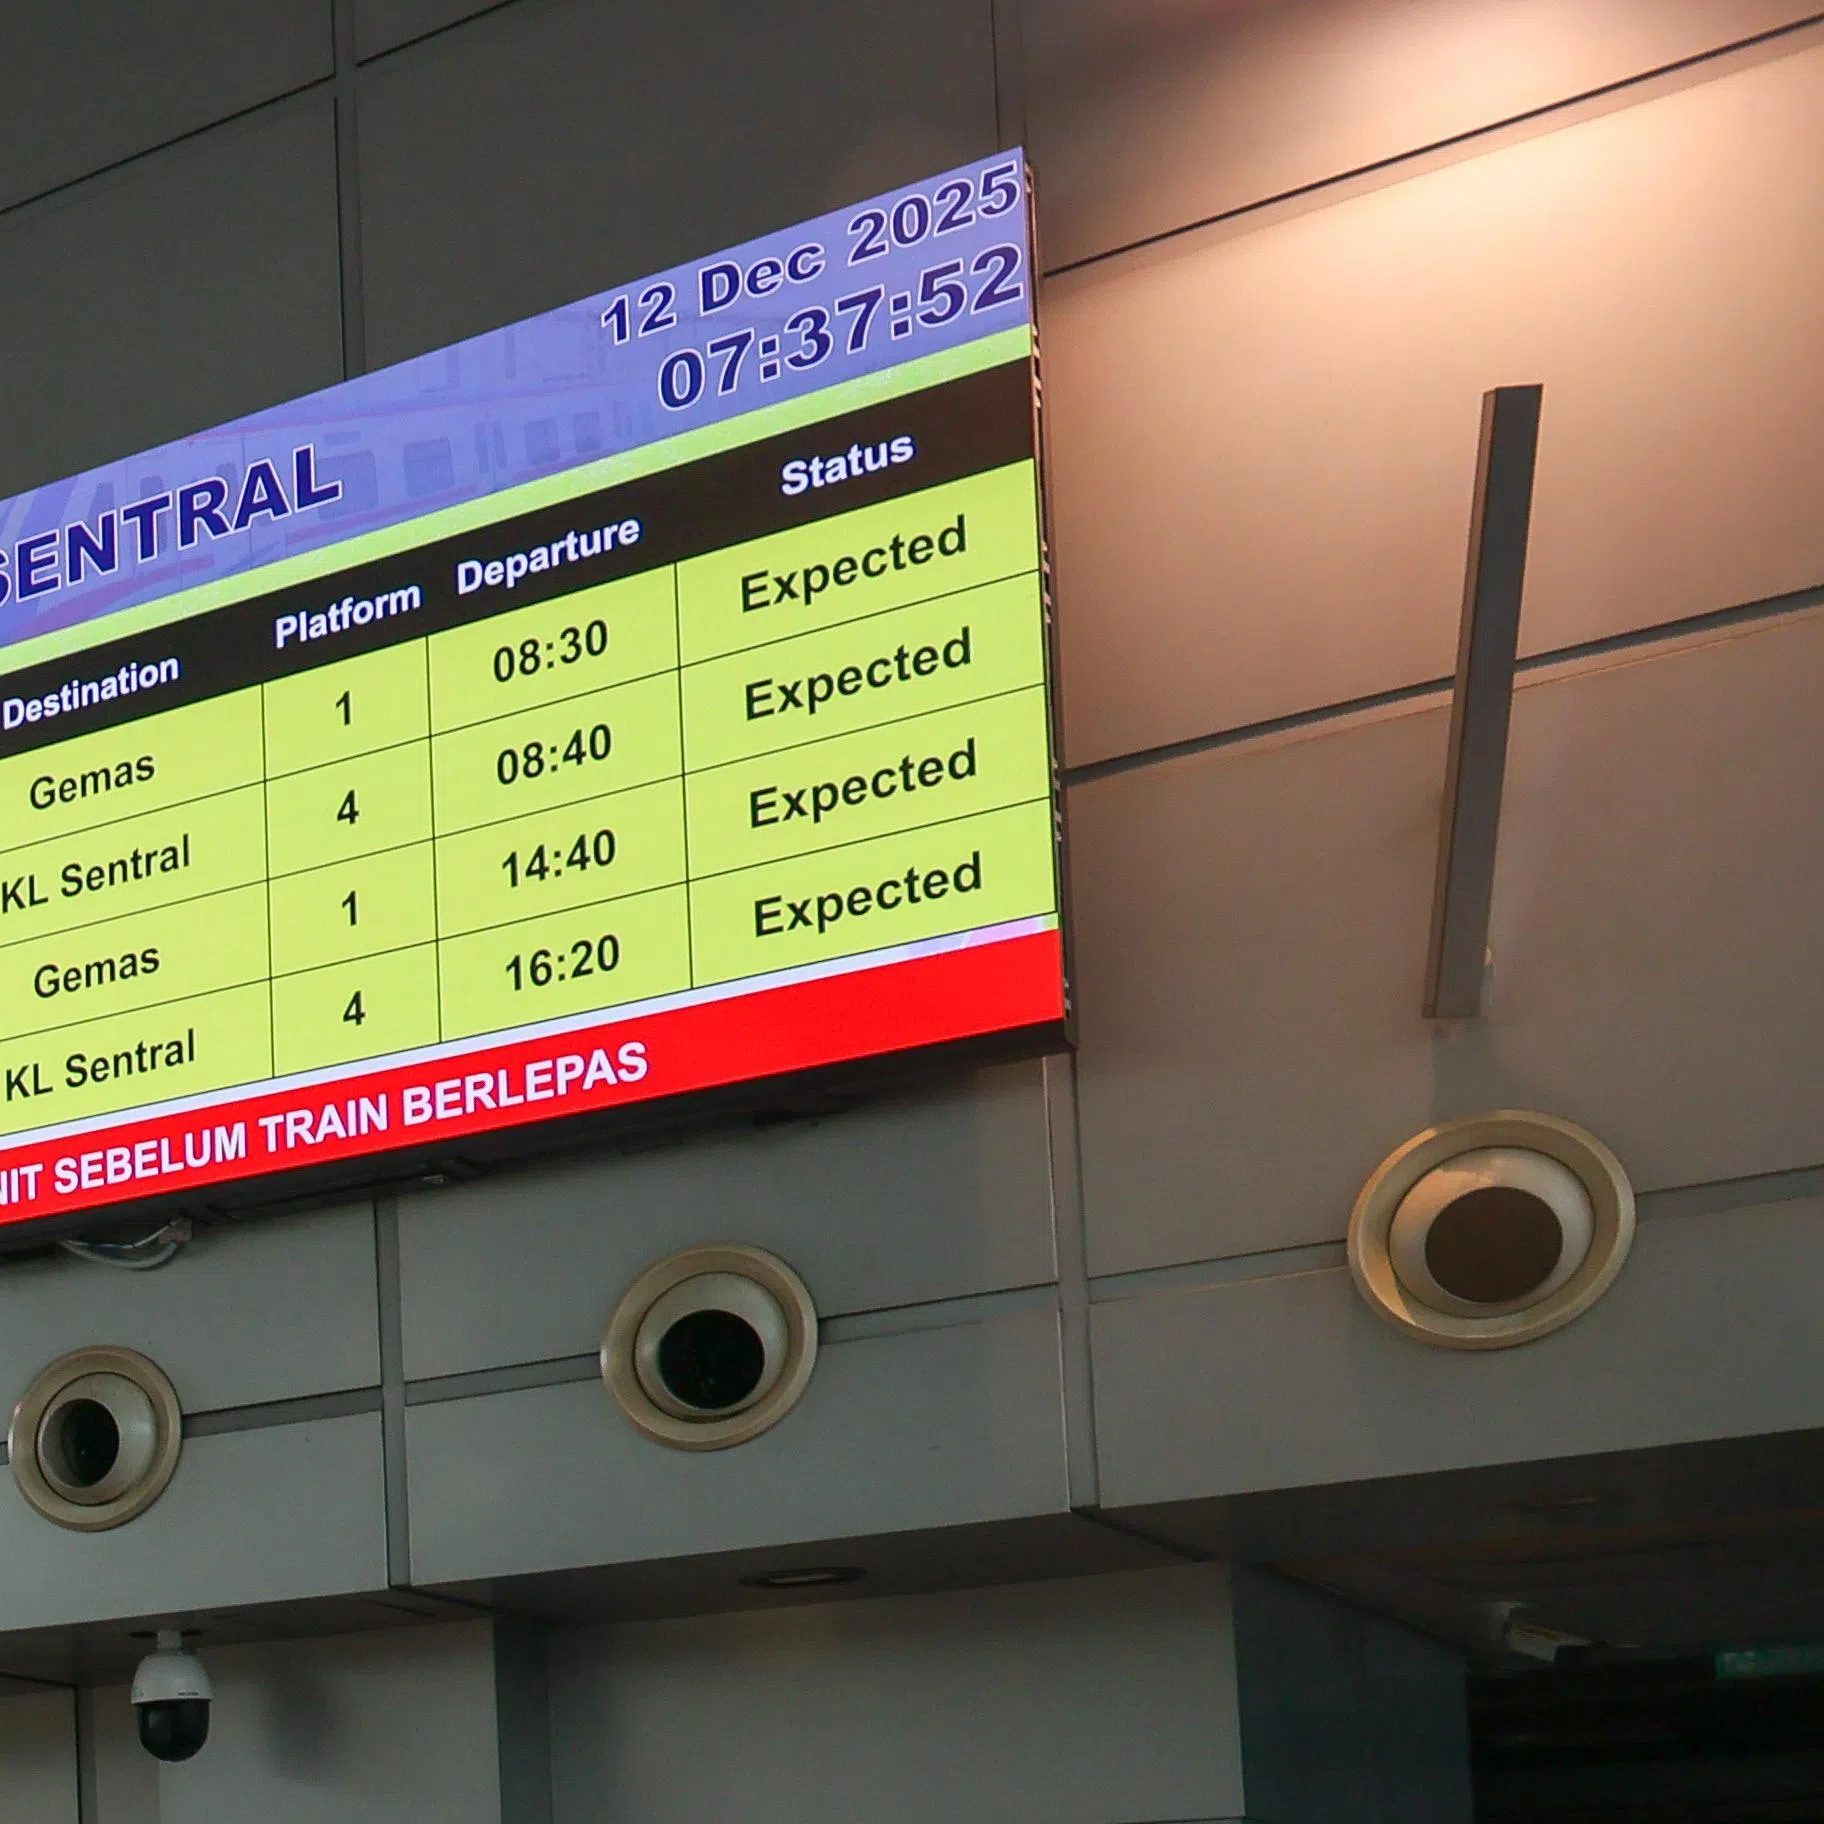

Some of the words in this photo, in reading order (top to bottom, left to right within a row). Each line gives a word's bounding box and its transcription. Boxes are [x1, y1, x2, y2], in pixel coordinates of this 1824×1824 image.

[599, 288, 678, 347] 12
[696, 240, 826, 317] Dec
[847, 157, 1021, 256] 2025
[656, 242, 1024, 414] 07:37:52
[779, 430, 916, 498] Status
[454, 513, 643, 599] Departure
[738, 513, 970, 616] Expected
[273, 581, 423, 651] Platform
[491, 617, 611, 685] 08:30
[1, 653, 181, 731] Destination
[333, 688, 355, 728] 1
[742, 626, 974, 725] Expected
[28, 747, 157, 813] Gemas
[495, 721, 614, 790] 08:40
[748, 739, 979, 833] Expected
[335, 788, 360, 827] 4
[0, 872, 54, 915] KL
[59, 833, 193, 903] Sentral
[500, 828, 617, 892] 14:40
[339, 890, 360, 928] 1
[752, 850, 984, 942] Expected
[32, 940, 161, 1003] Gemas
[505, 933, 622, 995] 16:20
[341, 990, 366, 1030] 4
[4, 1062, 59, 1104] KL
[63, 1027, 197, 1093] Sentral
[52, 1120, 248, 1195] SEBELUM
[260, 1095, 390, 1152] TRAIN
[400, 1041, 649, 1126] BERLEPAS
